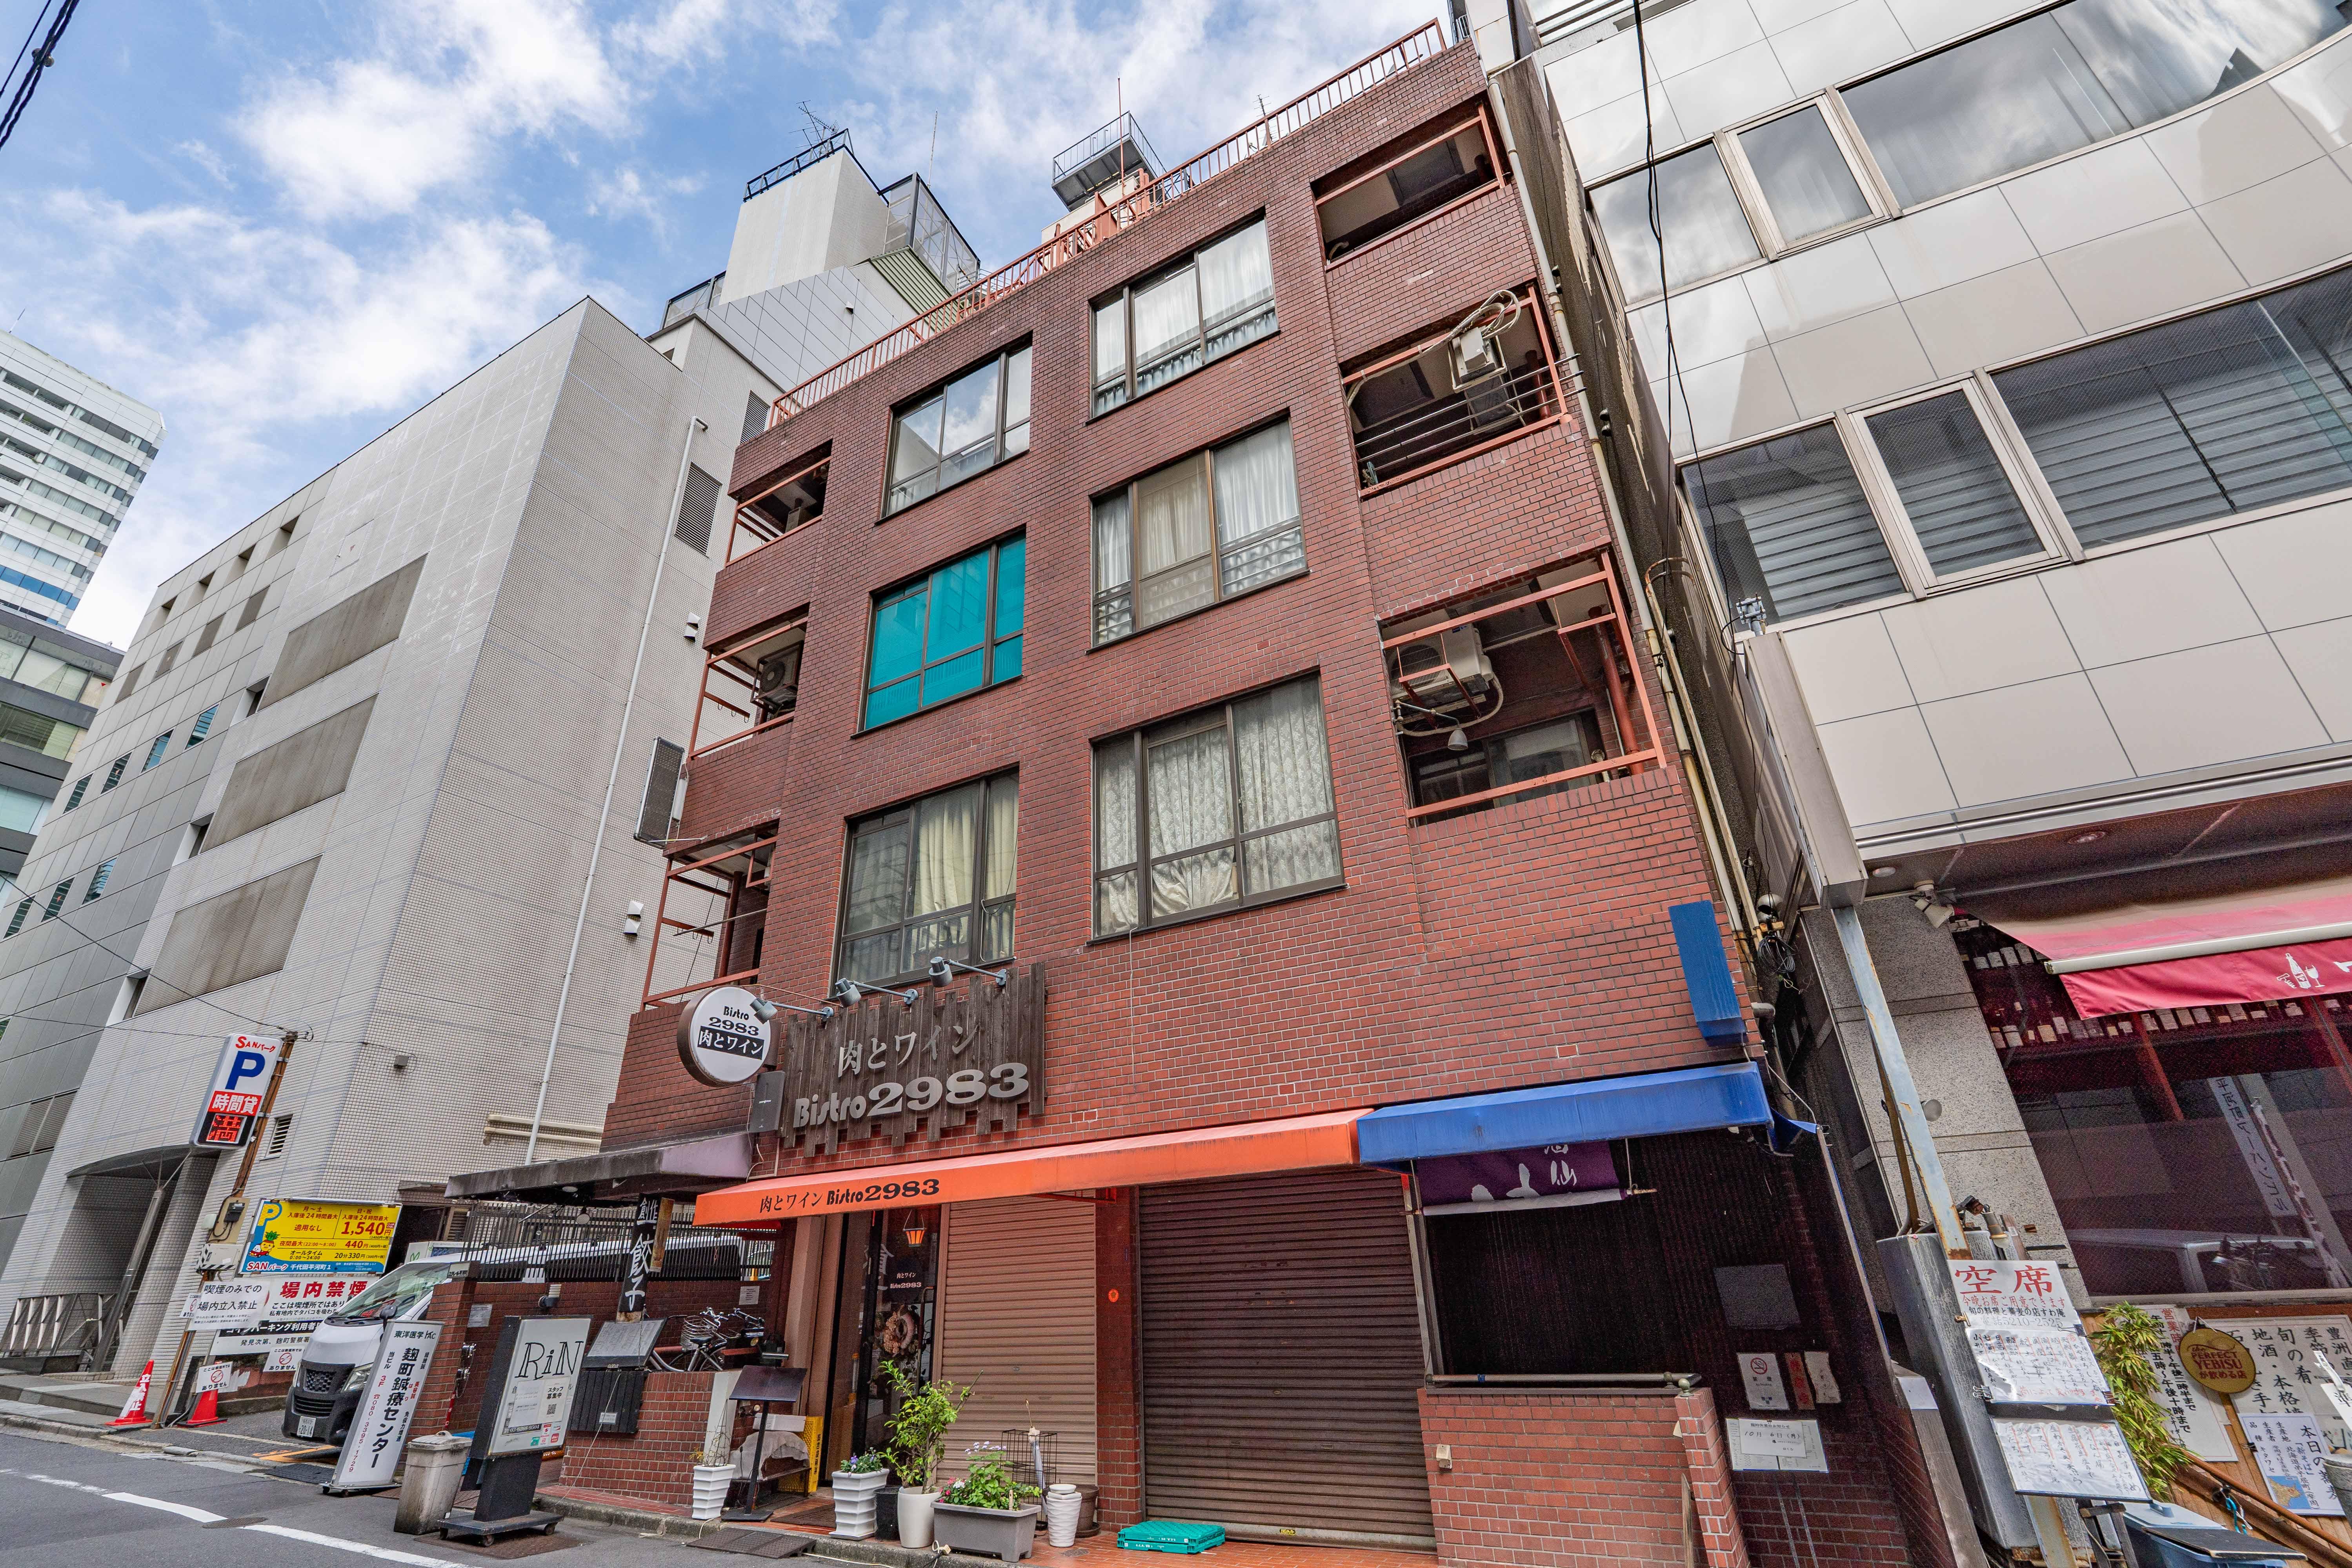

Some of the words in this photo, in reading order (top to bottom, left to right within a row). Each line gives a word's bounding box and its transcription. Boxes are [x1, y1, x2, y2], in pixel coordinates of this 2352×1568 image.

[723, 1006, 749, 1020] Bistro
[708, 1017, 759, 1036] 2983
[699, 1030, 763, 1055] 肉とワイン
[838, 1023, 979, 1078] 肉とワイン
[225, 1051, 265, 1090] P
[212, 1093, 258, 1114] 時間貸
[207, 1115, 241, 1142] 満
[638, 1197, 658, 1221] 創作
[759, 1191, 822, 1213] 肉とワイン
[247, 1261, 288, 1271] SANパーク
[625, 1233, 655, 1311] 餃子
[204, 1285, 262, 1294] 喫煙のみでの
[280, 1281, 368, 1299] 場内禁煙
[1955, 1265, 2052, 1297] 空席
[198, 1301, 257, 1311] 場内立入禁止
[1963, 1294, 2065, 1308] 今晩お席ご用意できます
[1969, 1306, 2066, 1317] 旬の料理と蕎麦の店すわ庵
[2162, 1308, 2183, 1351] 営業時
[384, 1352, 395, 1369] 当ビル
[515, 1341, 584, 1381] RiN
[2191, 1351, 2237, 1361] PERFECT
[2277, 1328, 2312, 1384] 旬の肴
[2327, 1327, 2352, 1376] 豊洲直
[2194, 1358, 2243, 1371] YEBISU
[202, 1382, 227, 1390] ありません
[378, 1375, 386, 1387] 3F
[2199, 1371, 2247, 1380] が飲める店
[371, 1347, 420, 1468] 麹町鍼療センター
[2249, 1421, 2263, 1442] 品種
[2263, 1421, 2276, 1442] 生産者
[2276, 1421, 2291, 1442] 生産地
